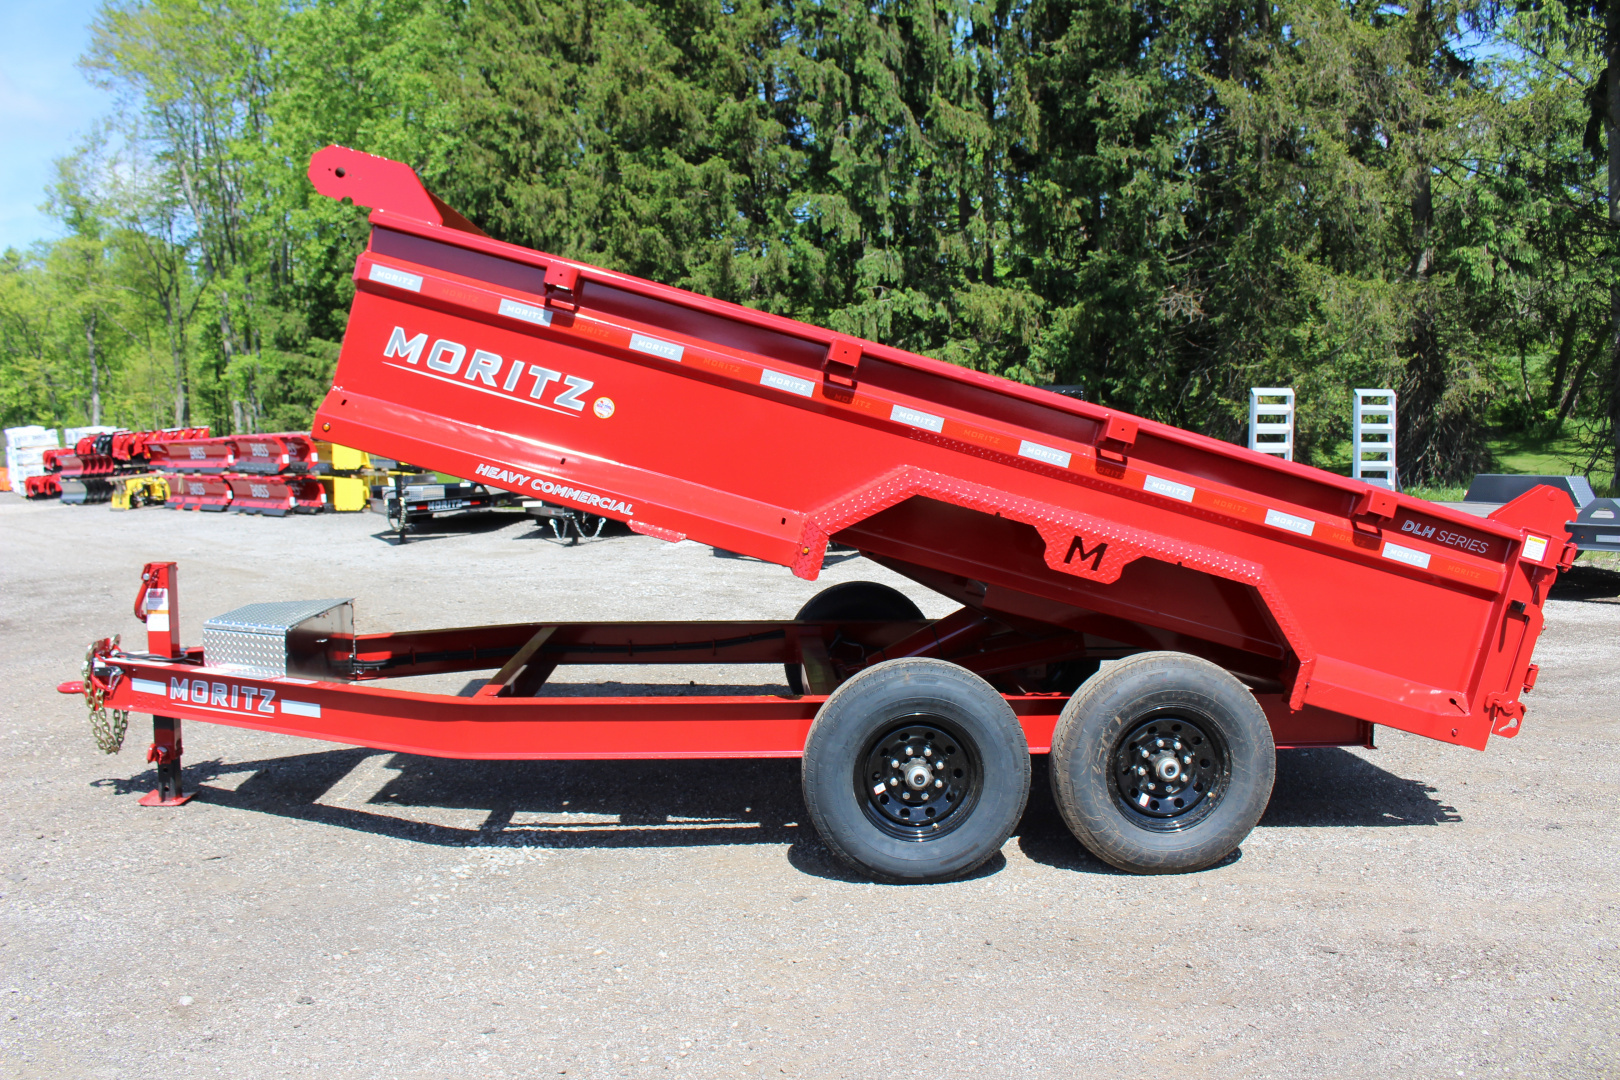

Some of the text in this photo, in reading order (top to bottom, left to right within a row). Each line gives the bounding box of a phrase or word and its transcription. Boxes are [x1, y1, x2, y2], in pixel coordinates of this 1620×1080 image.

[376, 270, 415, 286] MORITZ
[441, 287, 479, 303] MORITZ
[507, 305, 544, 321] MORITZ
[573, 322, 609, 338] MORITZ
[637, 339, 675, 355] MORITZ
[383, 326, 594, 411] MORITZ
[703, 357, 741, 373] MORITZ
[768, 375, 807, 391] MORITZ
[834, 393, 871, 409] MORITZ
[899, 411, 937, 427] MORITZ
[963, 429, 1000, 444] MORITZ
[189, 446, 206, 459] BOSS
[250, 443, 269, 457] BOSS
[1027, 446, 1063, 462] MORITZ
[1089, 464, 1125, 479] MORITZ
[189, 483, 205, 495] BOSS
[250, 484, 269, 498] BOSS
[475, 463, 634, 516] HEAVY COMMERCIAL
[1151, 481, 1187, 497] MORITZ
[427, 499, 463, 510] MORITZ
[1213, 498, 1248, 514] MORITZ
[1273, 515, 1308, 531] MORITZ
[1332, 532, 1366, 547] MORITZ
[1401, 519, 1489, 554] DLH SERIES
[1063, 535, 1108, 571] M
[1390, 548, 1424, 563] MORITZ
[1447, 564, 1481, 579] MORITZ
[169, 677, 276, 714] MORITZ
